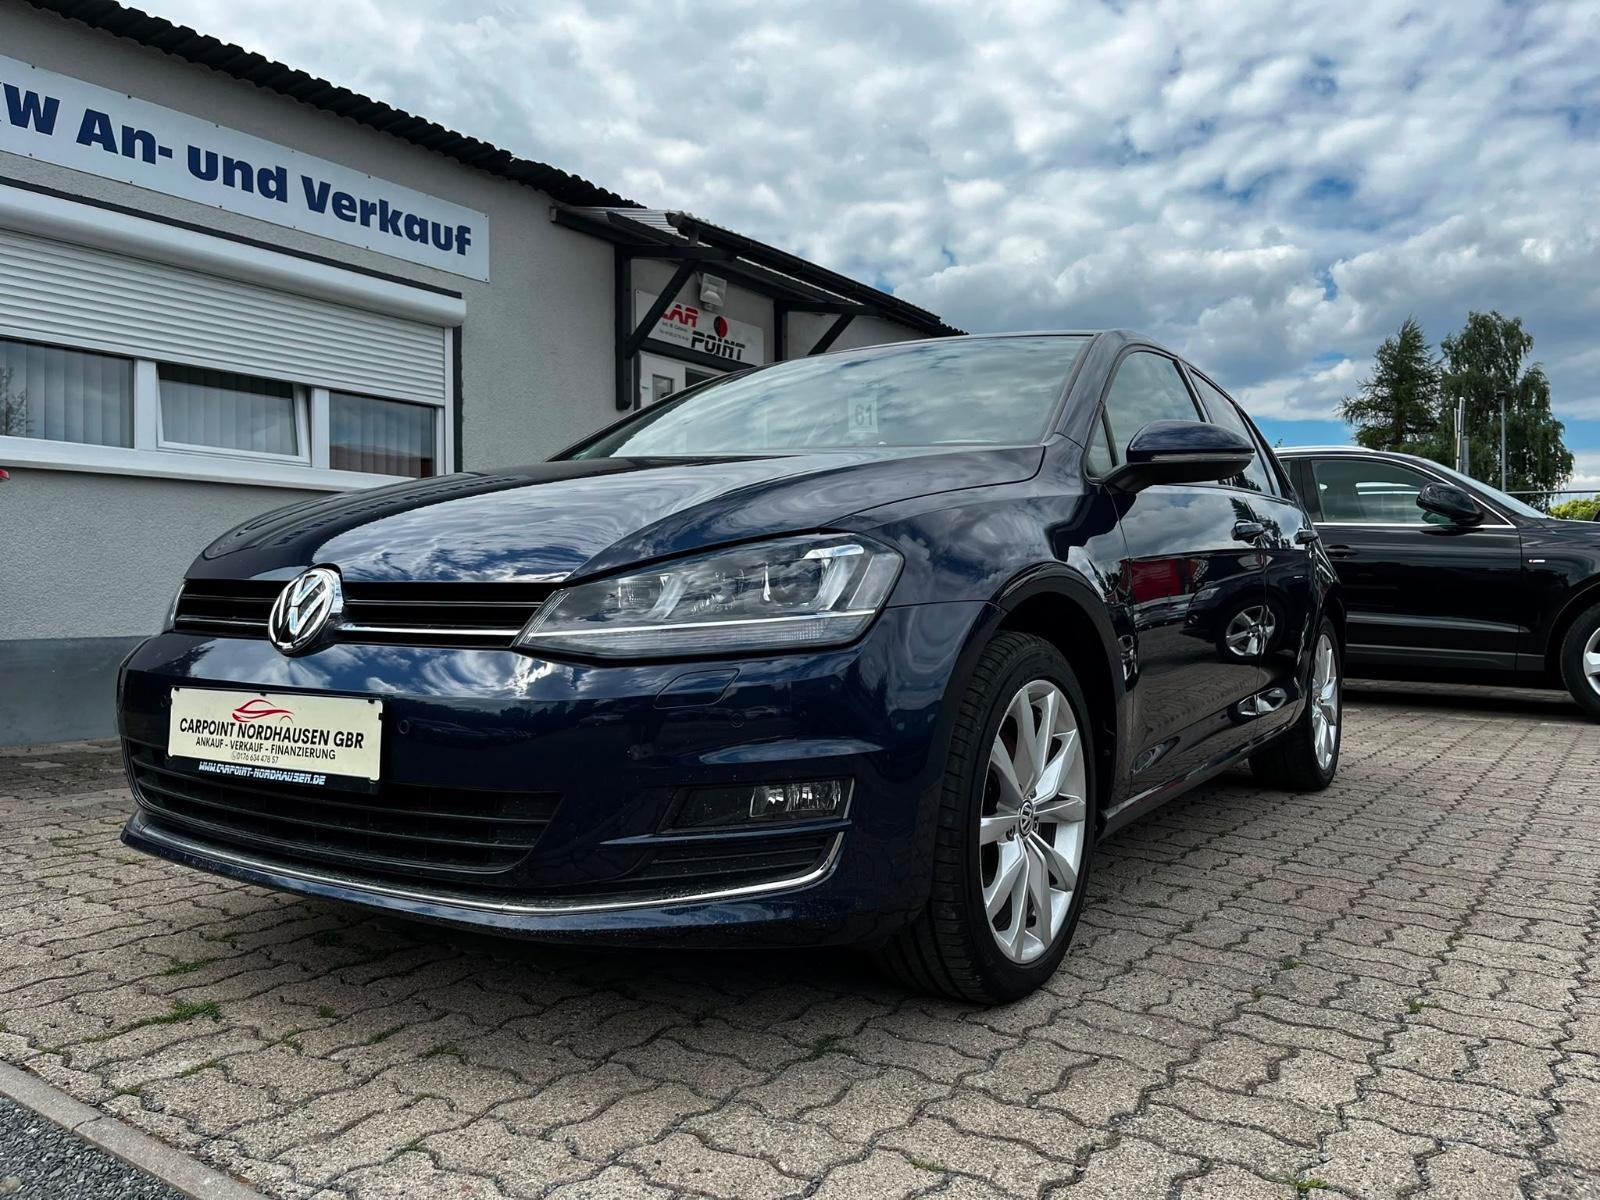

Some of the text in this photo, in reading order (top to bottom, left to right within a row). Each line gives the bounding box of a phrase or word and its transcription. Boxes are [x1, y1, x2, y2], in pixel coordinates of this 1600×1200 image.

[0, 82, 472, 256] W An- und Verkauf
[180, 718, 364, 749] CARPOINT NORDHAUSEN GBR
[196, 736, 223, 749] ANKAUF
[230, 740, 263, 753] VERKAUF
[271, 744, 336, 760] FINANZIERUNG
